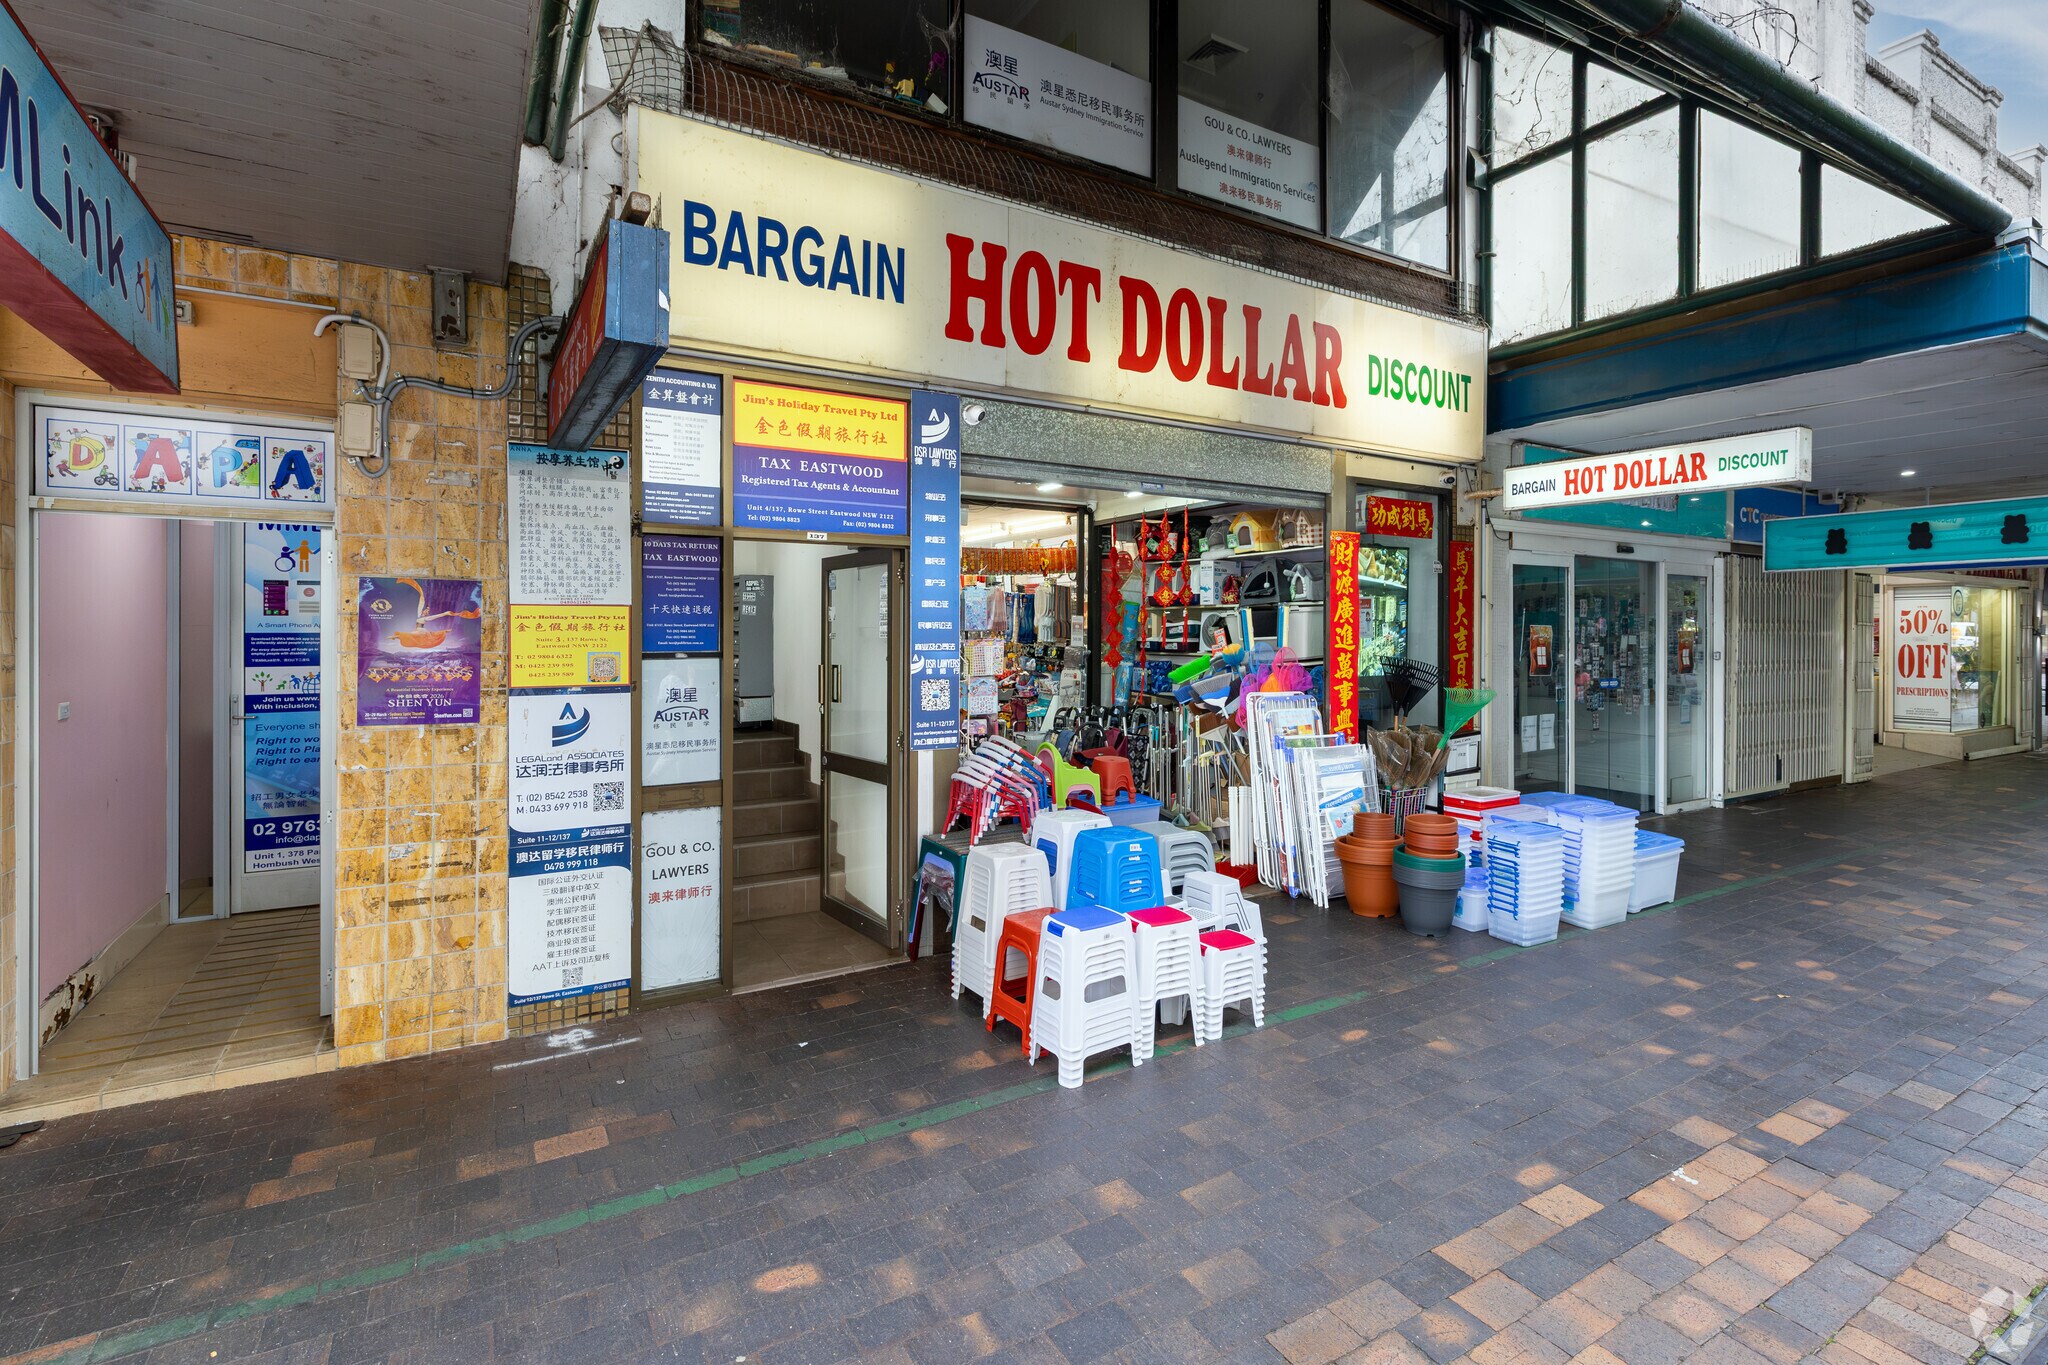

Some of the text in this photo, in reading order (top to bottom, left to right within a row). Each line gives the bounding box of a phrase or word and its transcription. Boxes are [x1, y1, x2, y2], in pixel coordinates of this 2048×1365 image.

[985, 48, 1019, 77] 澳星
[972, 71, 1030, 102] AUSTAR
[1040, 78, 1145, 128] 澳星悉尼移民事务所
[1040, 96, 1144, 138] Austar Sydney Immigration Service
[1204, 115, 1292, 156] GOU & CO. LAWYERS
[1227, 144, 1272, 169] 澳来律师行
[1179, 148, 1316, 203] Auslegend Immigration Services
[1219, 182, 1282, 212] 澳来移民事务所
[684, 199, 905, 305] BARGAIN
[944, 233, 1101, 363] HOT
[1118, 275, 1347, 409] DOLLAR
[1368, 353, 1471, 413] DISCOUNT
[666, 378, 701, 387] ACCOUNTING
[648, 387, 714, 406] 金算盤會計
[743, 394, 898, 422] Jim's Holiday Travel Pty Ltd
[754, 416, 888, 445] 金色假期旅行社
[536, 452, 600, 468] 按摩养生馆
[914, 446, 956, 461] DSR LAWYERS
[759, 456, 883, 479] TAX EASTWOOD
[1511, 449, 1789, 496] BARGAIN HOT DOLLAR DISCOUNT
[741, 475, 899, 496] Registered Tax Agents & Accountant
[747, 504, 763, 512] Unit
[830, 509, 861, 518] Eastwood
[862, 511, 877, 519] NSW
[1740, 507, 1760, 524] CTC
[643, 553, 718, 563] TAX EASTWOOD
[515, 622, 626, 633] 金色假期旅行社
[1900, 609, 1947, 635] 50%
[1898, 643, 1948, 679] OFF
[665, 687, 698, 703] 澳星
[1896, 686, 1949, 698] PRESCRIPTIONS
[387, 698, 452, 708] SHEN YUN
[653, 706, 709, 723] AUSTAR
[256, 723, 305, 733] Everyone
[256, 737, 286, 746] Right
[645, 738, 717, 751] 澳星悉尼移民事务所
[256, 747, 286, 757] Right
[567, 750, 625, 760] ASSOCIATES
[256, 757, 286, 767] Right
[516, 759, 625, 779] 达润法律事务所
[516, 790, 588, 803] T: (02) 8542 2538
[529, 801, 588, 814] 0433 699 918
[253, 824, 276, 836] 02
[537, 833, 571, 844] 11-12/137
[254, 852, 274, 860] Unit
[288, 850, 304, 858] 378
[516, 842, 624, 863] 澳达留学移民律师行
[645, 841, 715, 858] GOU & CO.
[253, 859, 299, 869] Hombush
[544, 858, 598, 871] 0478 999 118
[652, 863, 709, 880] LAWYERS
[538, 871, 604, 887] 国际公证外交认证
[648, 885, 713, 904] 澳来律师行
[546, 903, 596, 917] 学生留学签证
[546, 924, 596, 938] 技术移民签证
